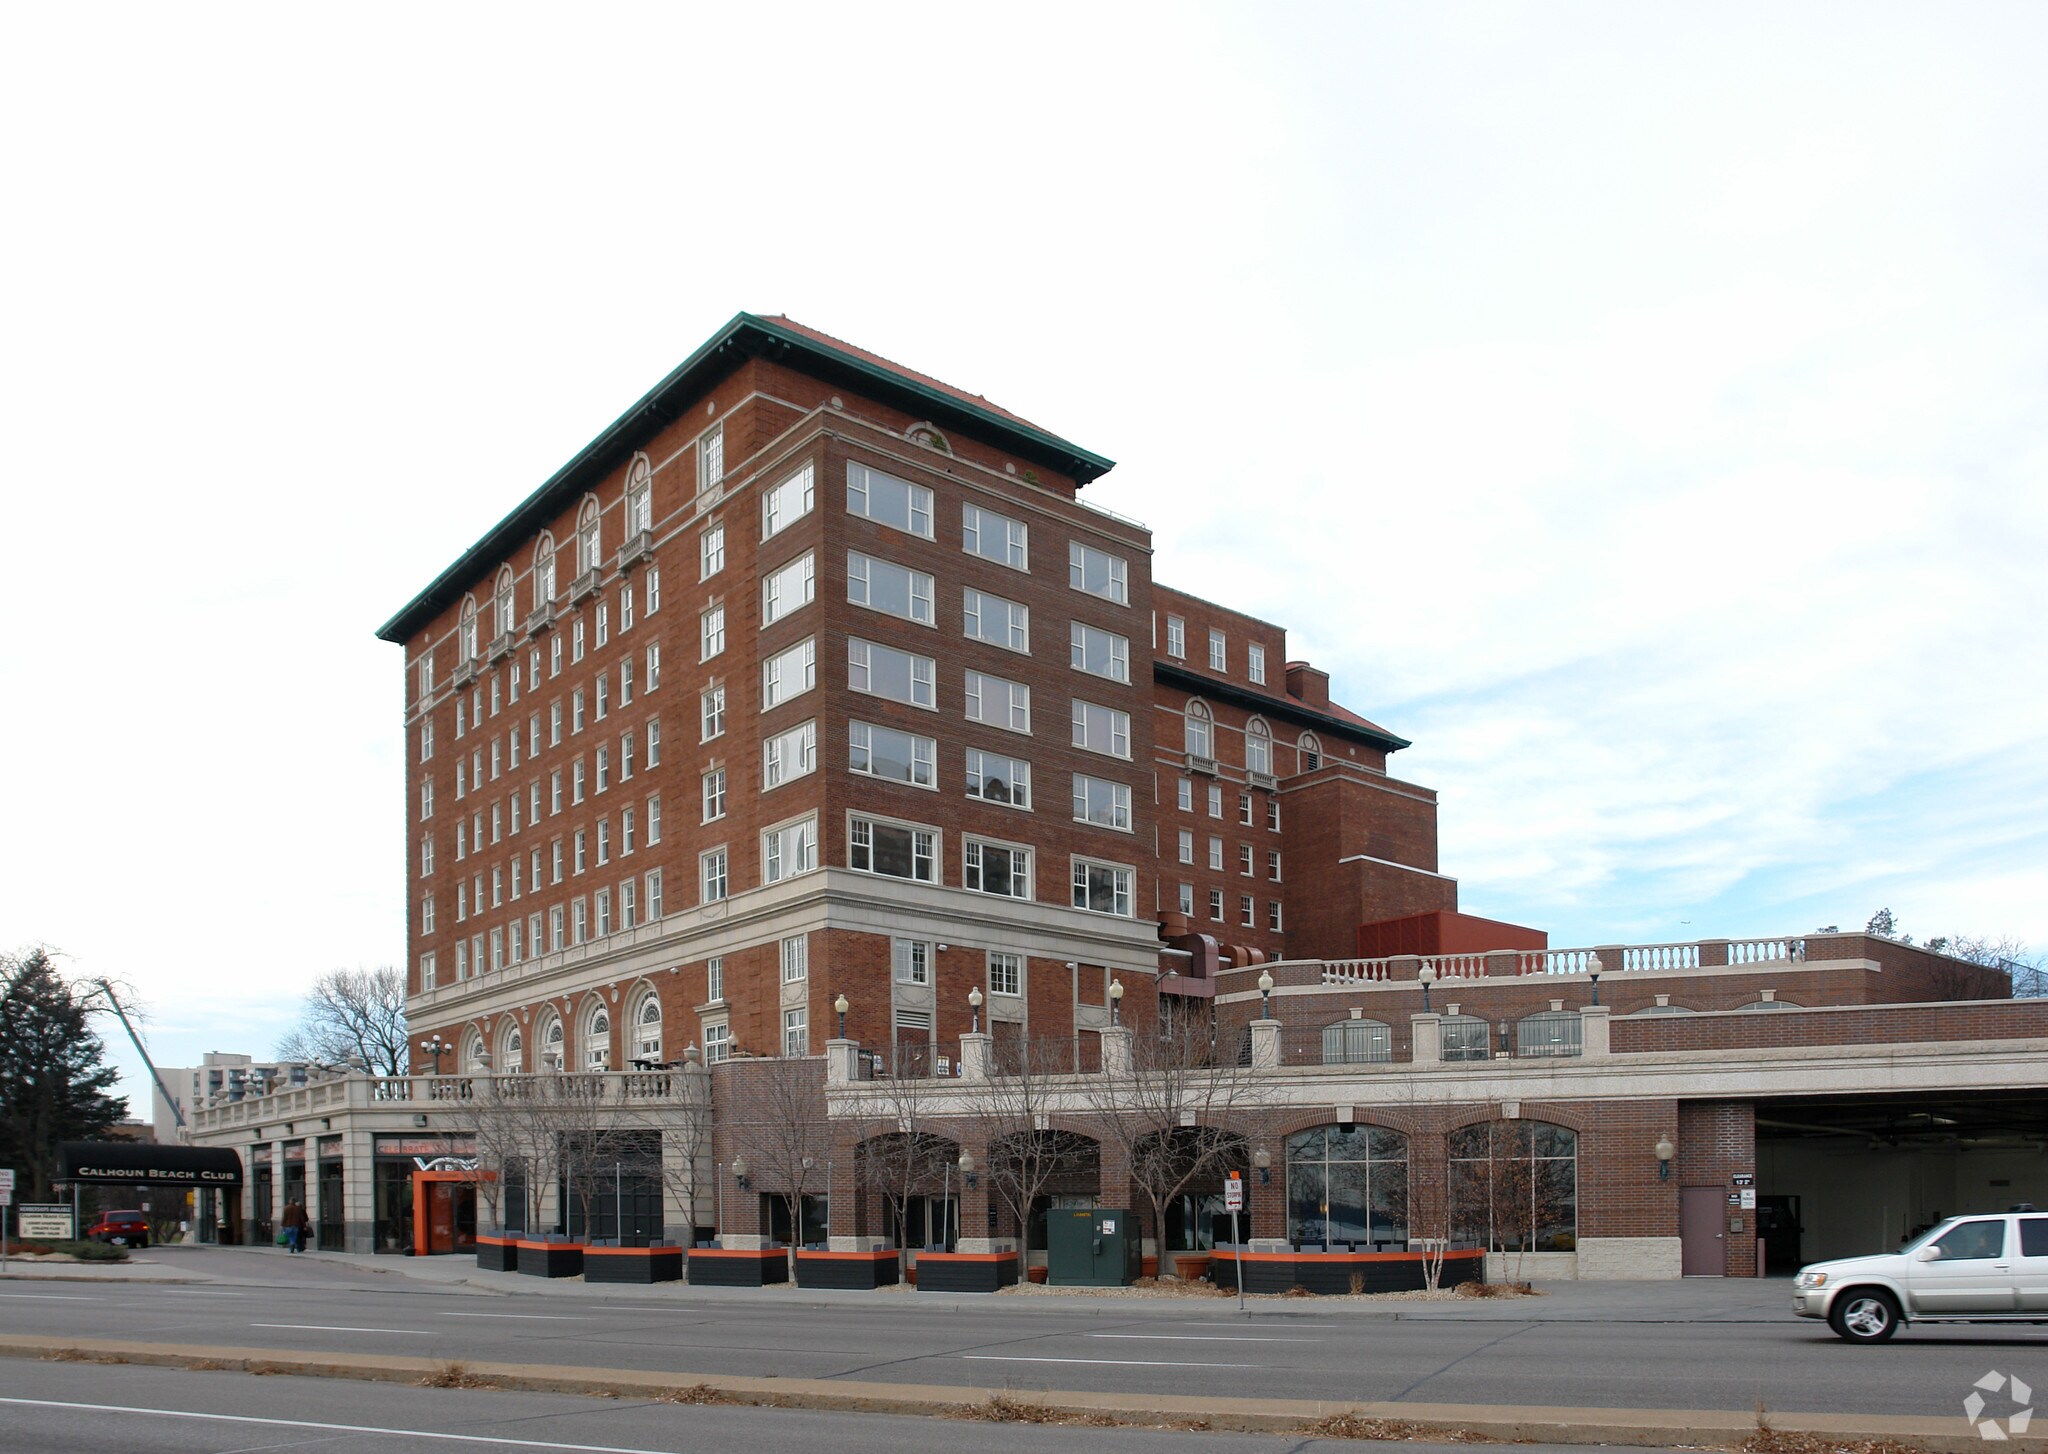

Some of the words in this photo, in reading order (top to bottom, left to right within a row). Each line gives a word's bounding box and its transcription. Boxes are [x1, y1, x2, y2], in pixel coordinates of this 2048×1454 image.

[78, 1167, 144, 1177] CALHOUN
[148, 1169, 195, 1179] BEACH
[201, 1171, 235, 1180] CLUB
[1230, 1182, 1239, 1190] NO
